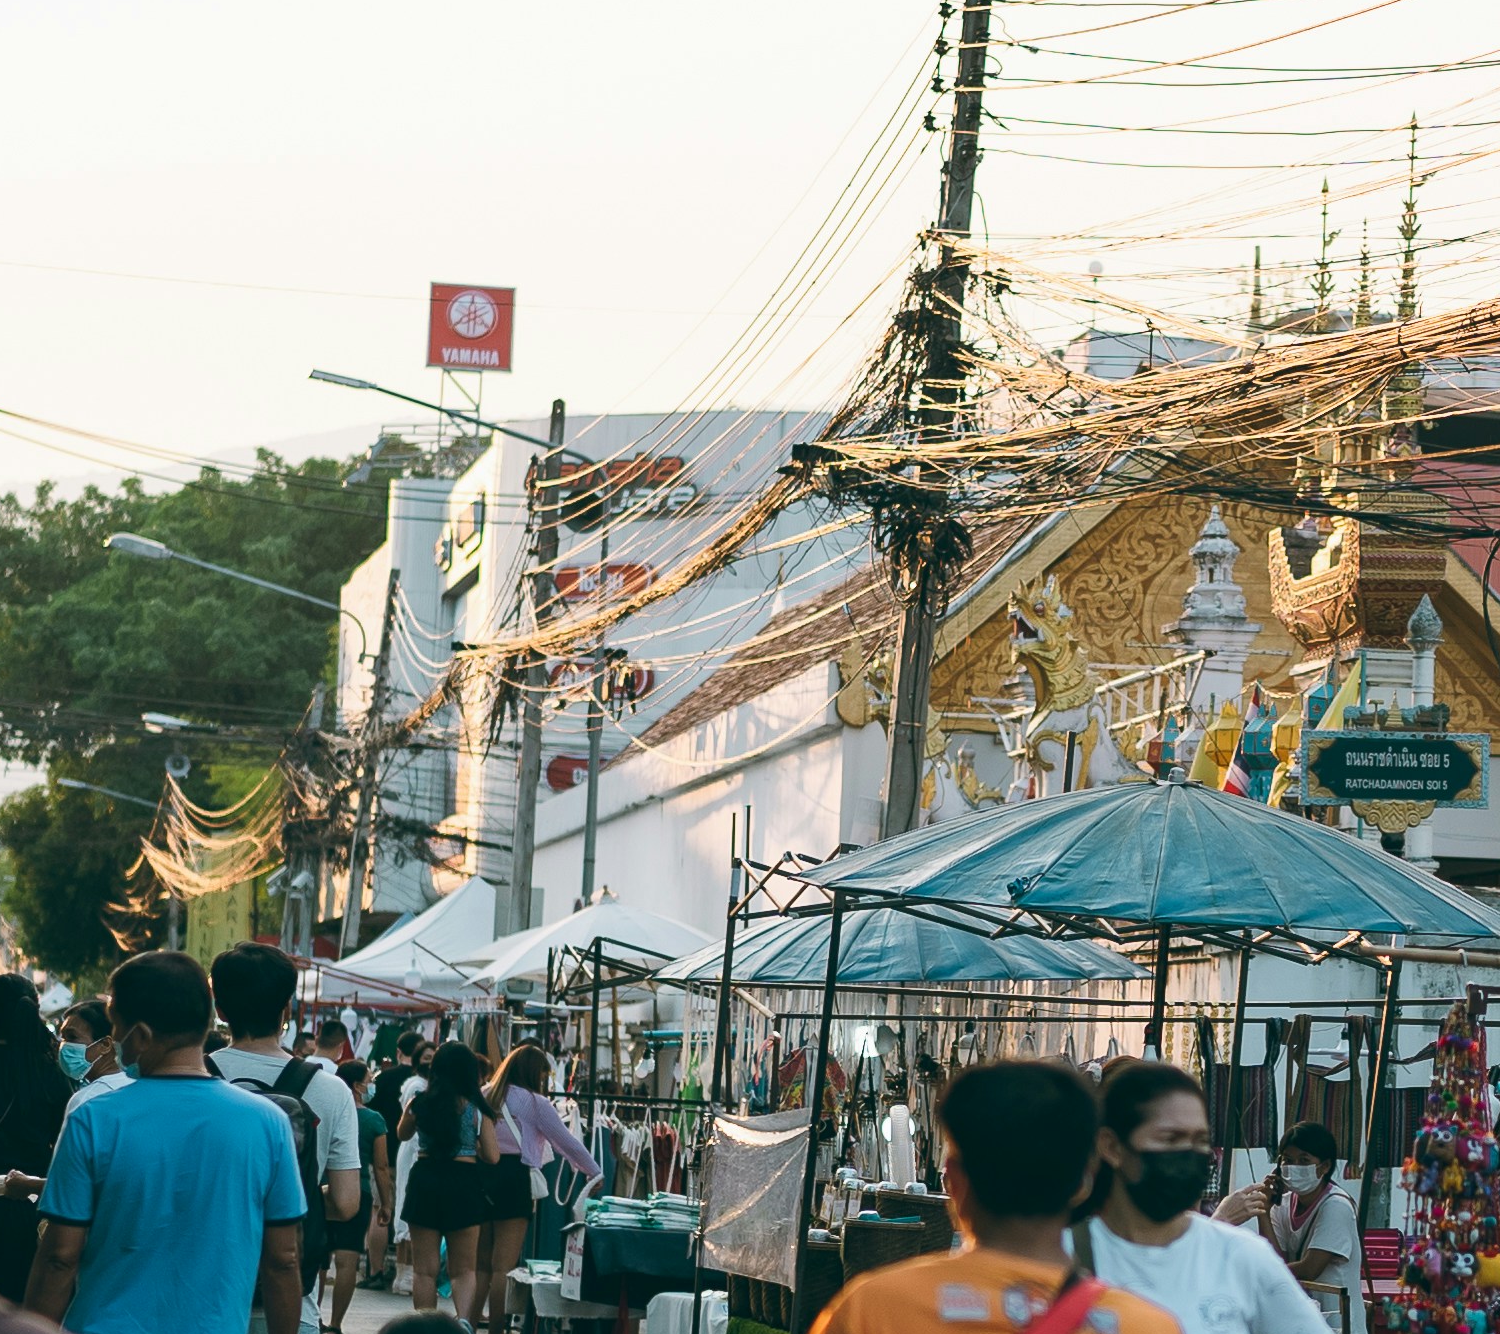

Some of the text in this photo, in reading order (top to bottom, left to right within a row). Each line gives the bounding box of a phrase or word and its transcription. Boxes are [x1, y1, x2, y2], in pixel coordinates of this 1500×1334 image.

[442, 347, 499, 366] YAMAHA
[1345, 746, 1418, 768] ถนนราชดำเนิน
[1443, 753, 1450, 768] 5
[1345, 778, 1448, 790] RATCHADAMNOEN SOI 5
